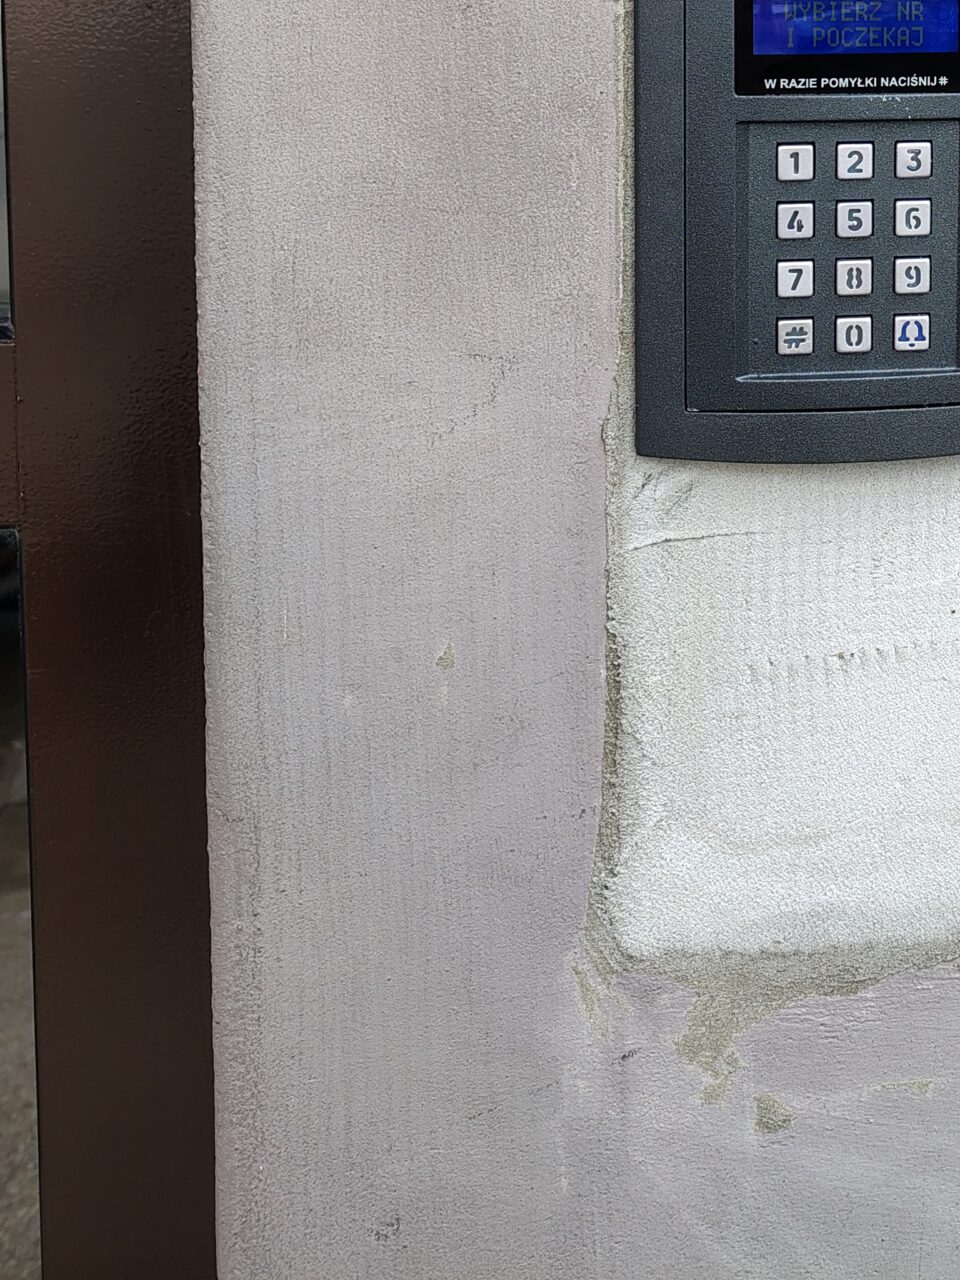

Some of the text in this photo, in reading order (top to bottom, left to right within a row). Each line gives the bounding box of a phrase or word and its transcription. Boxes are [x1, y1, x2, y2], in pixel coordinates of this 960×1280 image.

[783, 0, 924, 22] WYBIERZ NR
[786, 26, 924, 48] I POCZEKAJ
[764, 79, 777, 89] W
[780, 78, 817, 89] RAZIE
[820, 77, 877, 88] POMYŁKI
[789, 149, 922, 175] 1 2 3
[787, 207, 921, 232] 4 5 6
[788, 265, 921, 291] 7 8 9
[845, 324, 863, 347] 0
